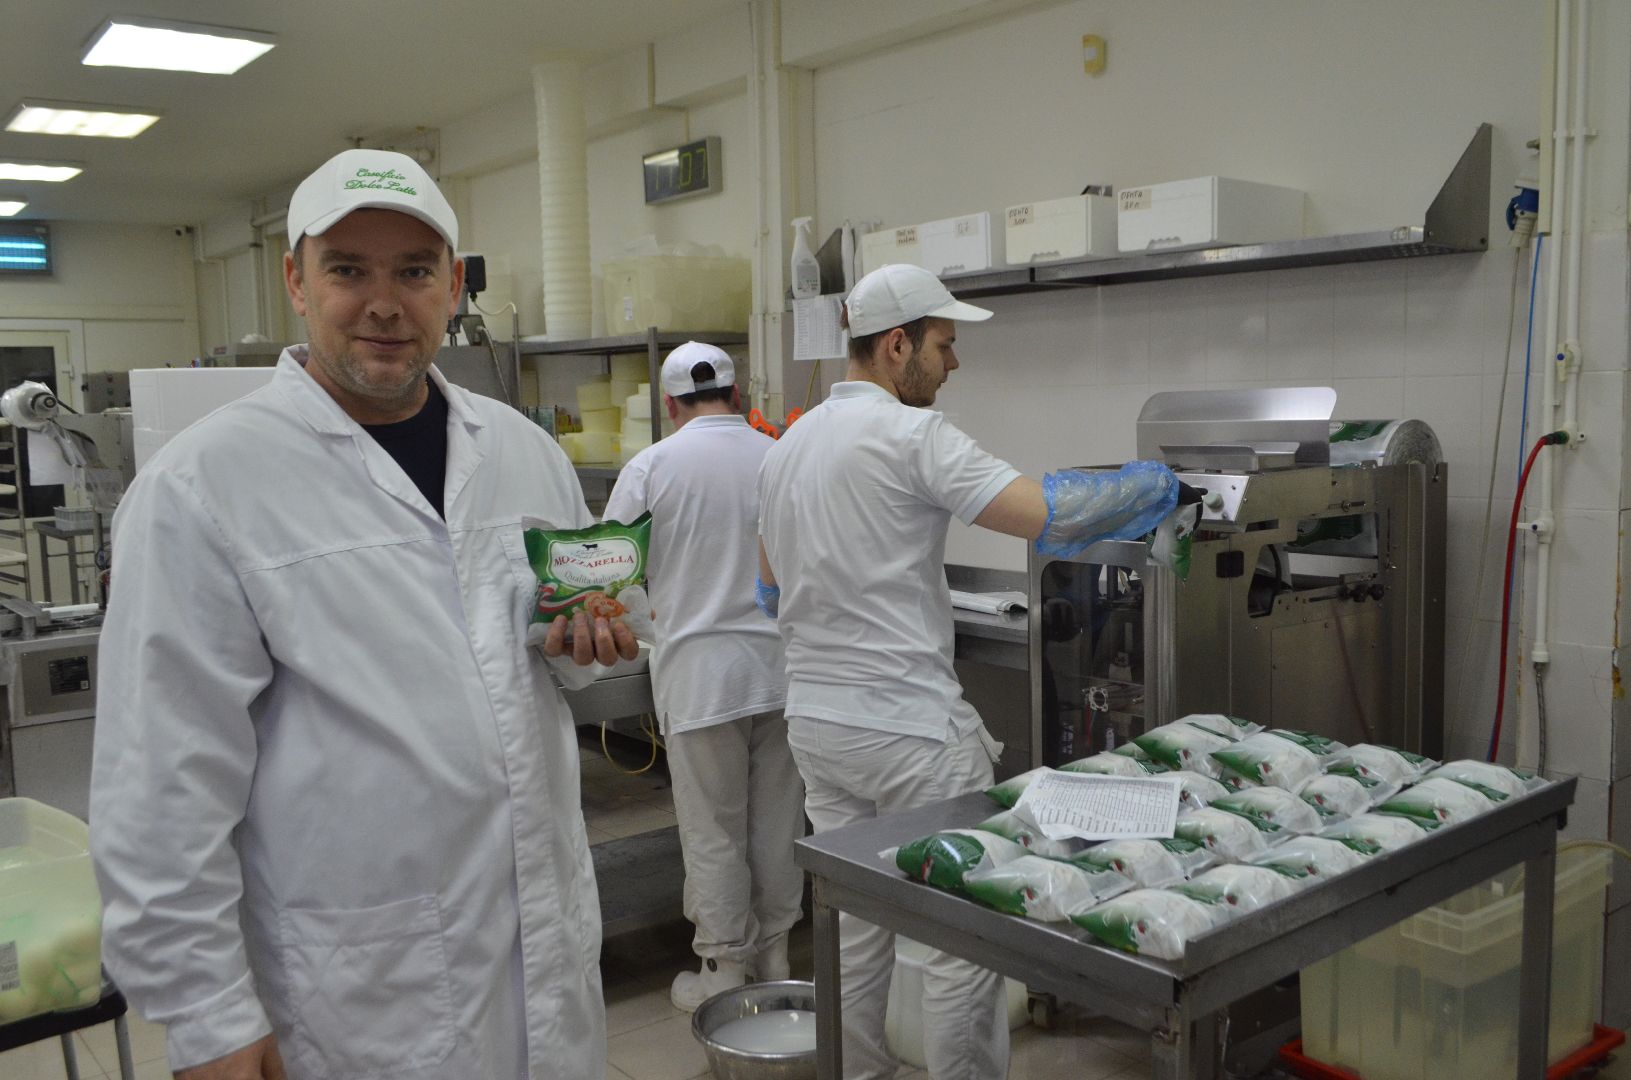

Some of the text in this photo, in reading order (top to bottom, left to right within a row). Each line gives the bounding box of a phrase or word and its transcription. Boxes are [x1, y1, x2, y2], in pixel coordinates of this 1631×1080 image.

[344, 179, 417, 195] Dolce Latte
[554, 555, 635, 569] MOZZARELLA
